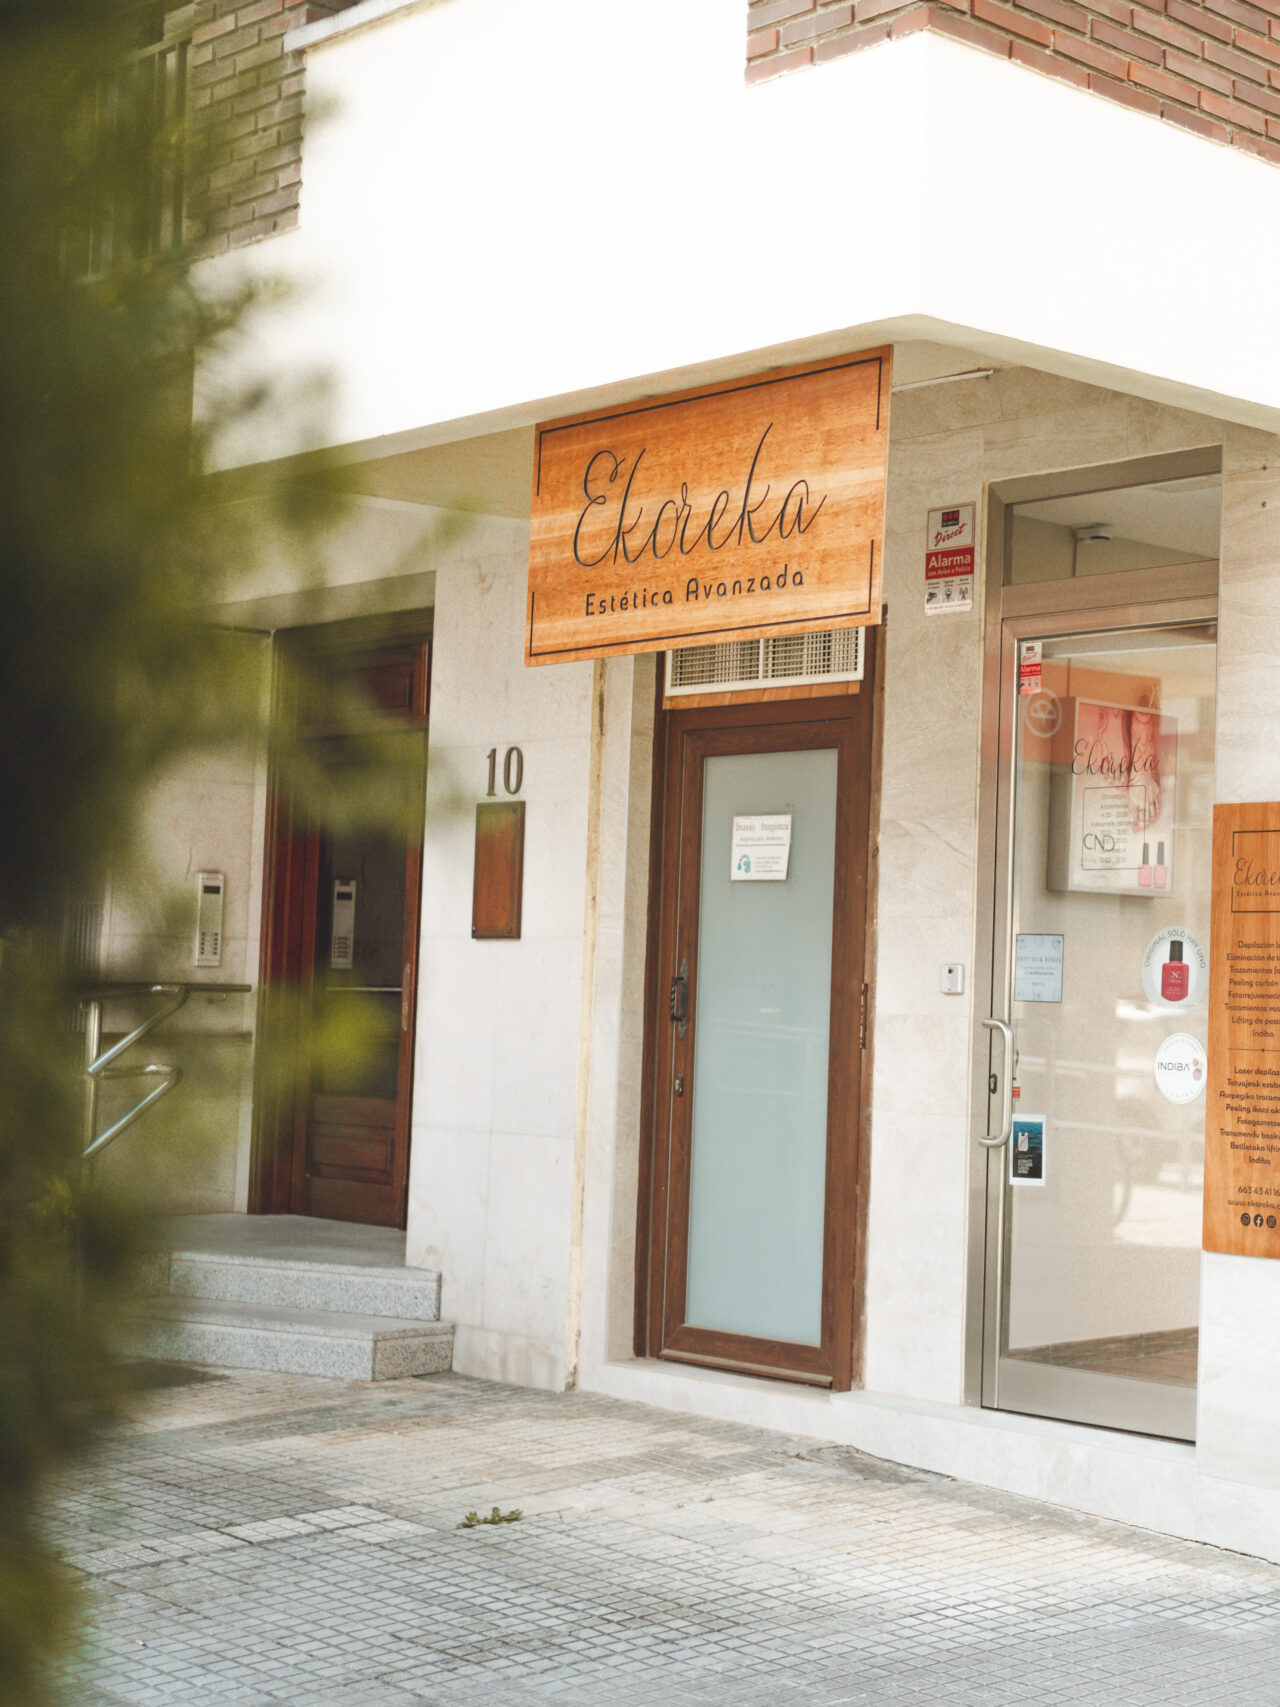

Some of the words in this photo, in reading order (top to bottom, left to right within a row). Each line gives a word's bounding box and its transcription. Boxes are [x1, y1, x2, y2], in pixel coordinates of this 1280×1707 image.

[573, 422, 827, 568] Ekoreka
[933, 523, 968, 547] Direct
[929, 554, 971, 569] Alarma
[585, 585, 673, 617] Estética
[686, 563, 804, 601] Avanzada
[1071, 736, 1158, 776] Ekoreka
[486, 746, 524, 797] 10
[1083, 833, 1115, 852] CND
[1144, 934, 1167, 968] ORIGINAL
[1167, 929, 1186, 938] SOLO
[1186, 934, 1199, 949] HAY
[1197, 948, 1207, 969] UNO
[1237, 940, 1275, 950] Depilación
[1226, 952, 1265, 962] Eliminación
[1266, 953, 1275, 961] de
[1229, 965, 1272, 974] Tratamientos
[1229, 978, 1253, 988] Peeling
[1255, 978, 1278, 987] carbón
[1224, 1002, 1267, 1012] Tratamientos
[1231, 1015, 1253, 1026] Lifting
[1254, 1016, 1263, 1024] de
[1252, 1029, 1274, 1038] Indiba
[1157, 1061, 1190, 1072] INDIBA
[1233, 1066, 1253, 1075] Laser
[1227, 1078, 1260, 1088] Tatuajeak
[1219, 1090, 1255, 1101] Aurpegiko
[1226, 1103, 1250, 1114] Peeling
[1219, 1128, 1259, 1138] Tratamendu
[1230, 1141, 1265, 1151] Betiletako
[1248, 1155, 1271, 1165] Indiba
[1238, 1185, 1252, 1194] 663
[1253, 1186, 1263, 1195] 43
[1264, 1187, 1272, 1196] 41
[1273, 1188, 1280, 1197] 16
